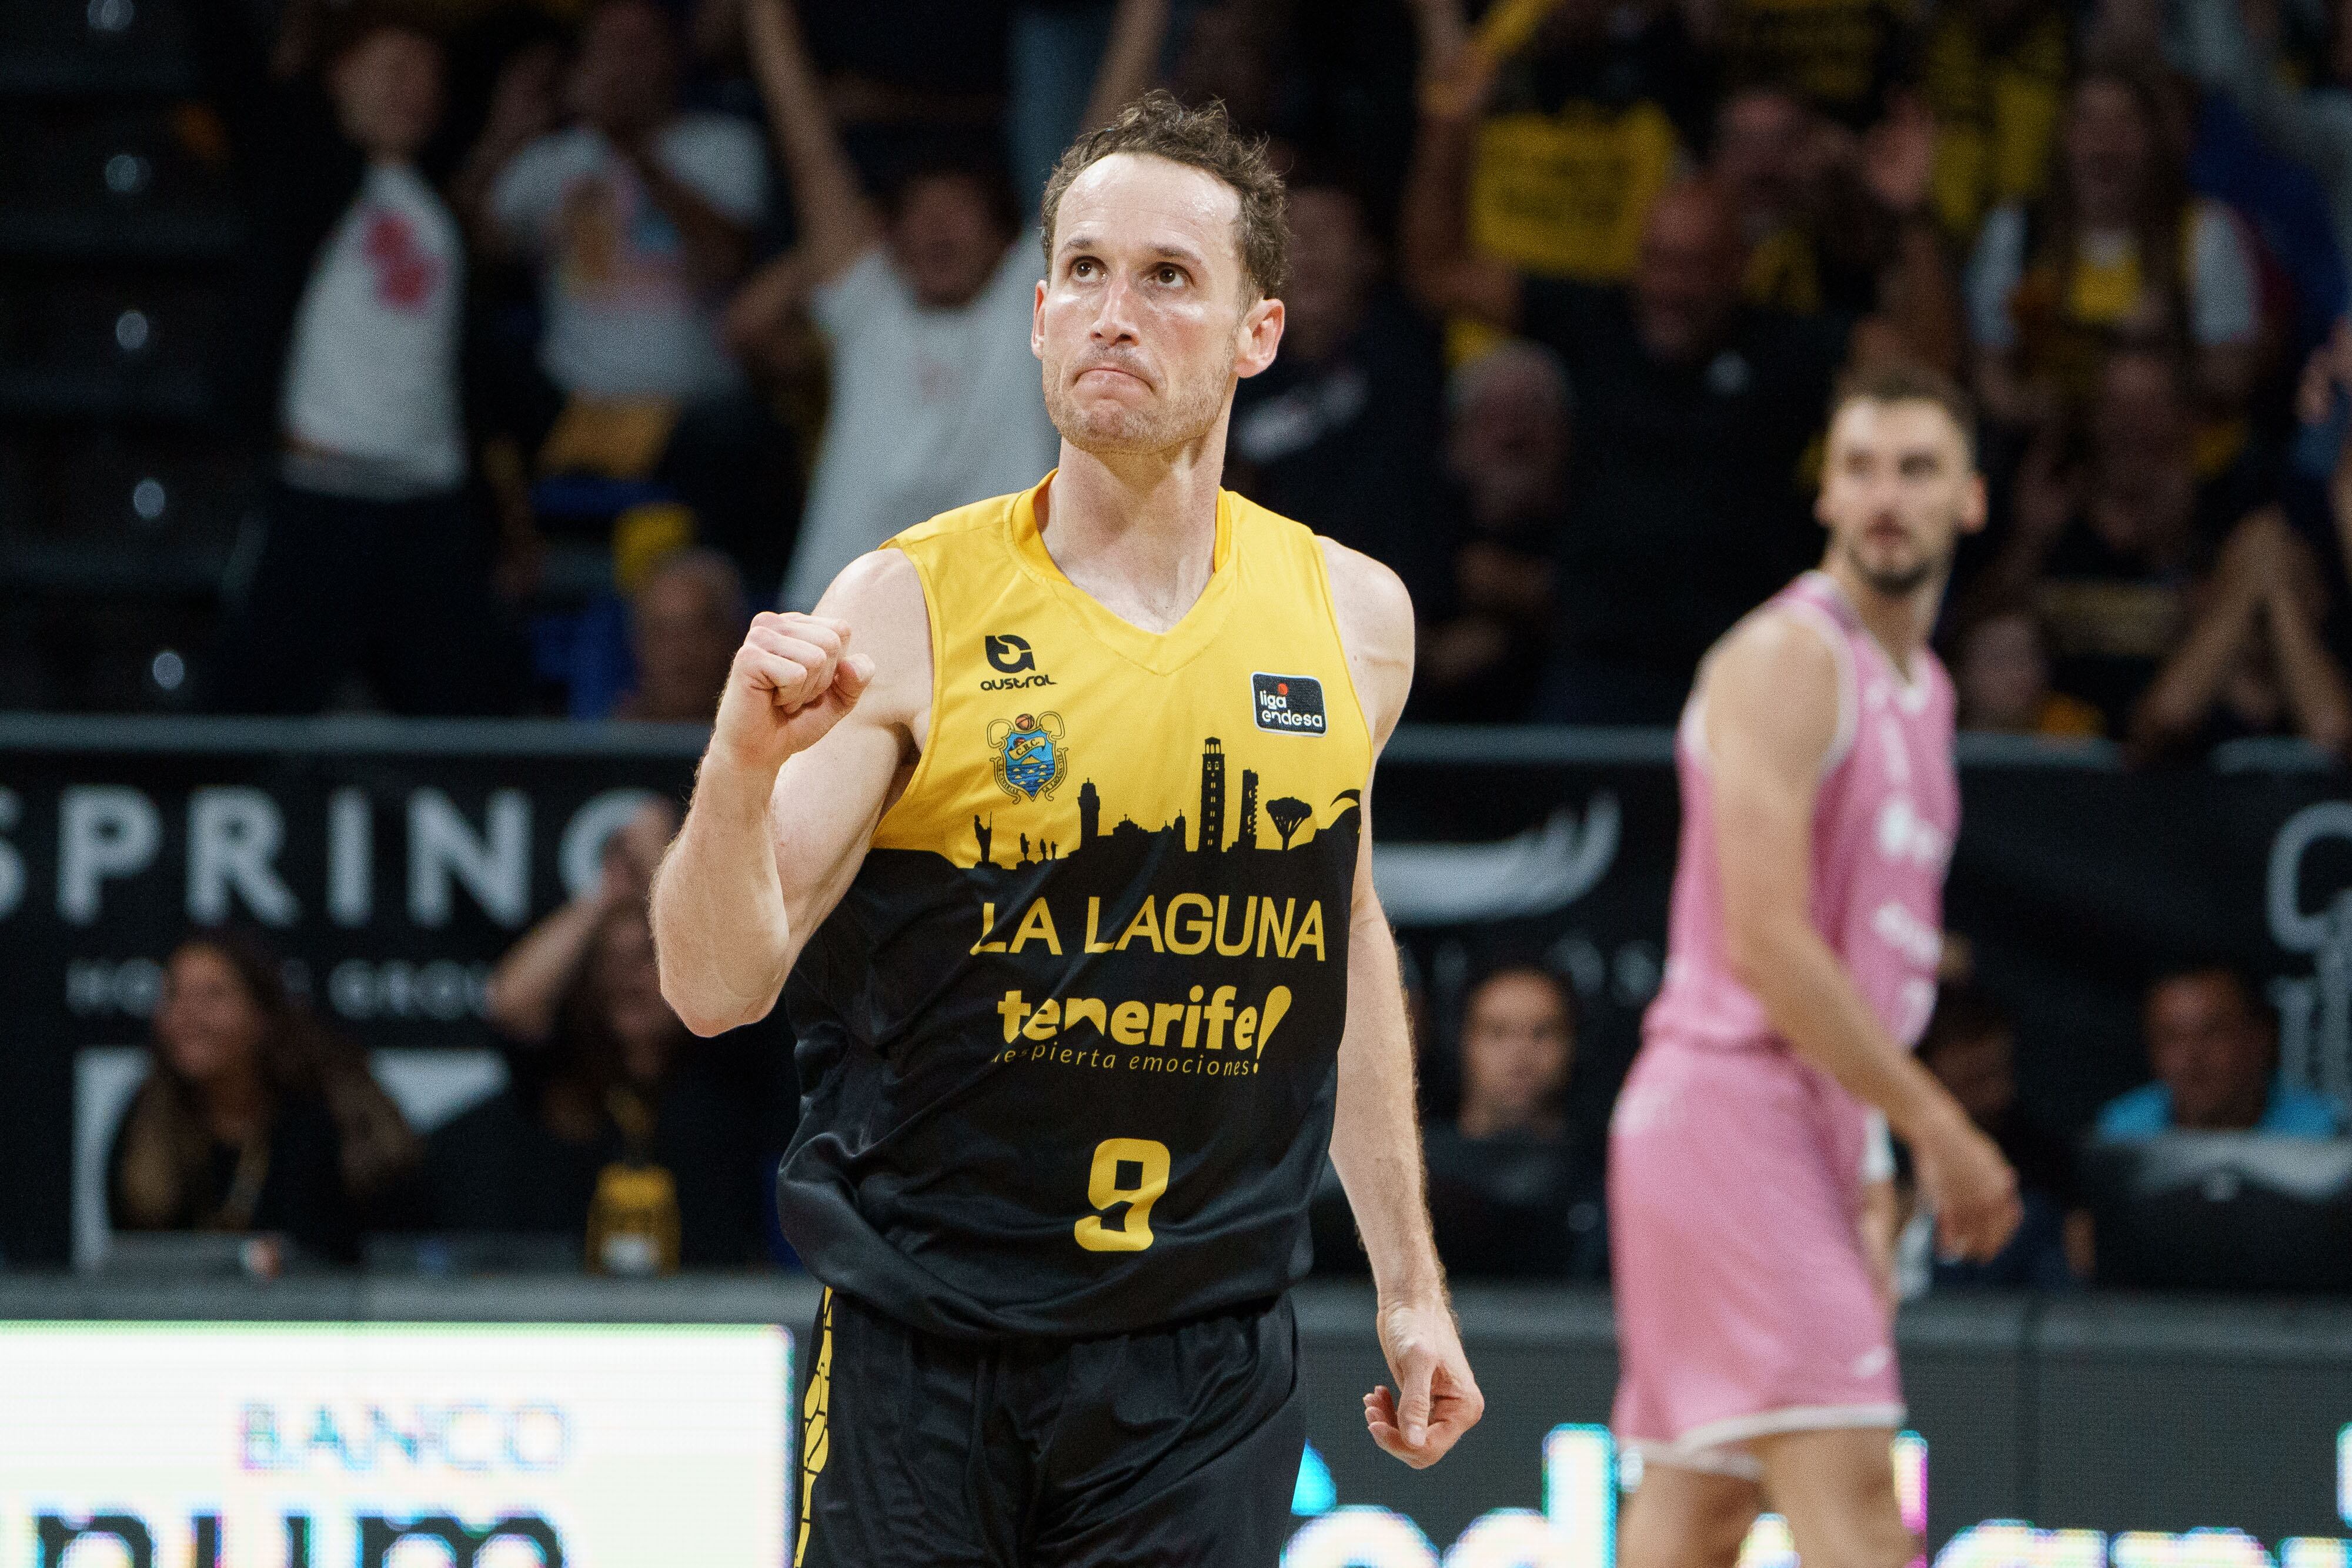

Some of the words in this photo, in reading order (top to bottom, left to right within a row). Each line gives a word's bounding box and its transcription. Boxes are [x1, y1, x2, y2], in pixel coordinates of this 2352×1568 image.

[980, 674, 1057, 691] austral
[1259, 690, 1287, 710] liga
[1261, 710, 1322, 728] endesa
[0, 785, 667, 929] PRIN
[970, 897, 1063, 955] LA
[1085, 892, 1326, 961] LAGUNA
[1074, 1138, 1171, 1252] 9
[239, 1400, 569, 1472] BANCO
